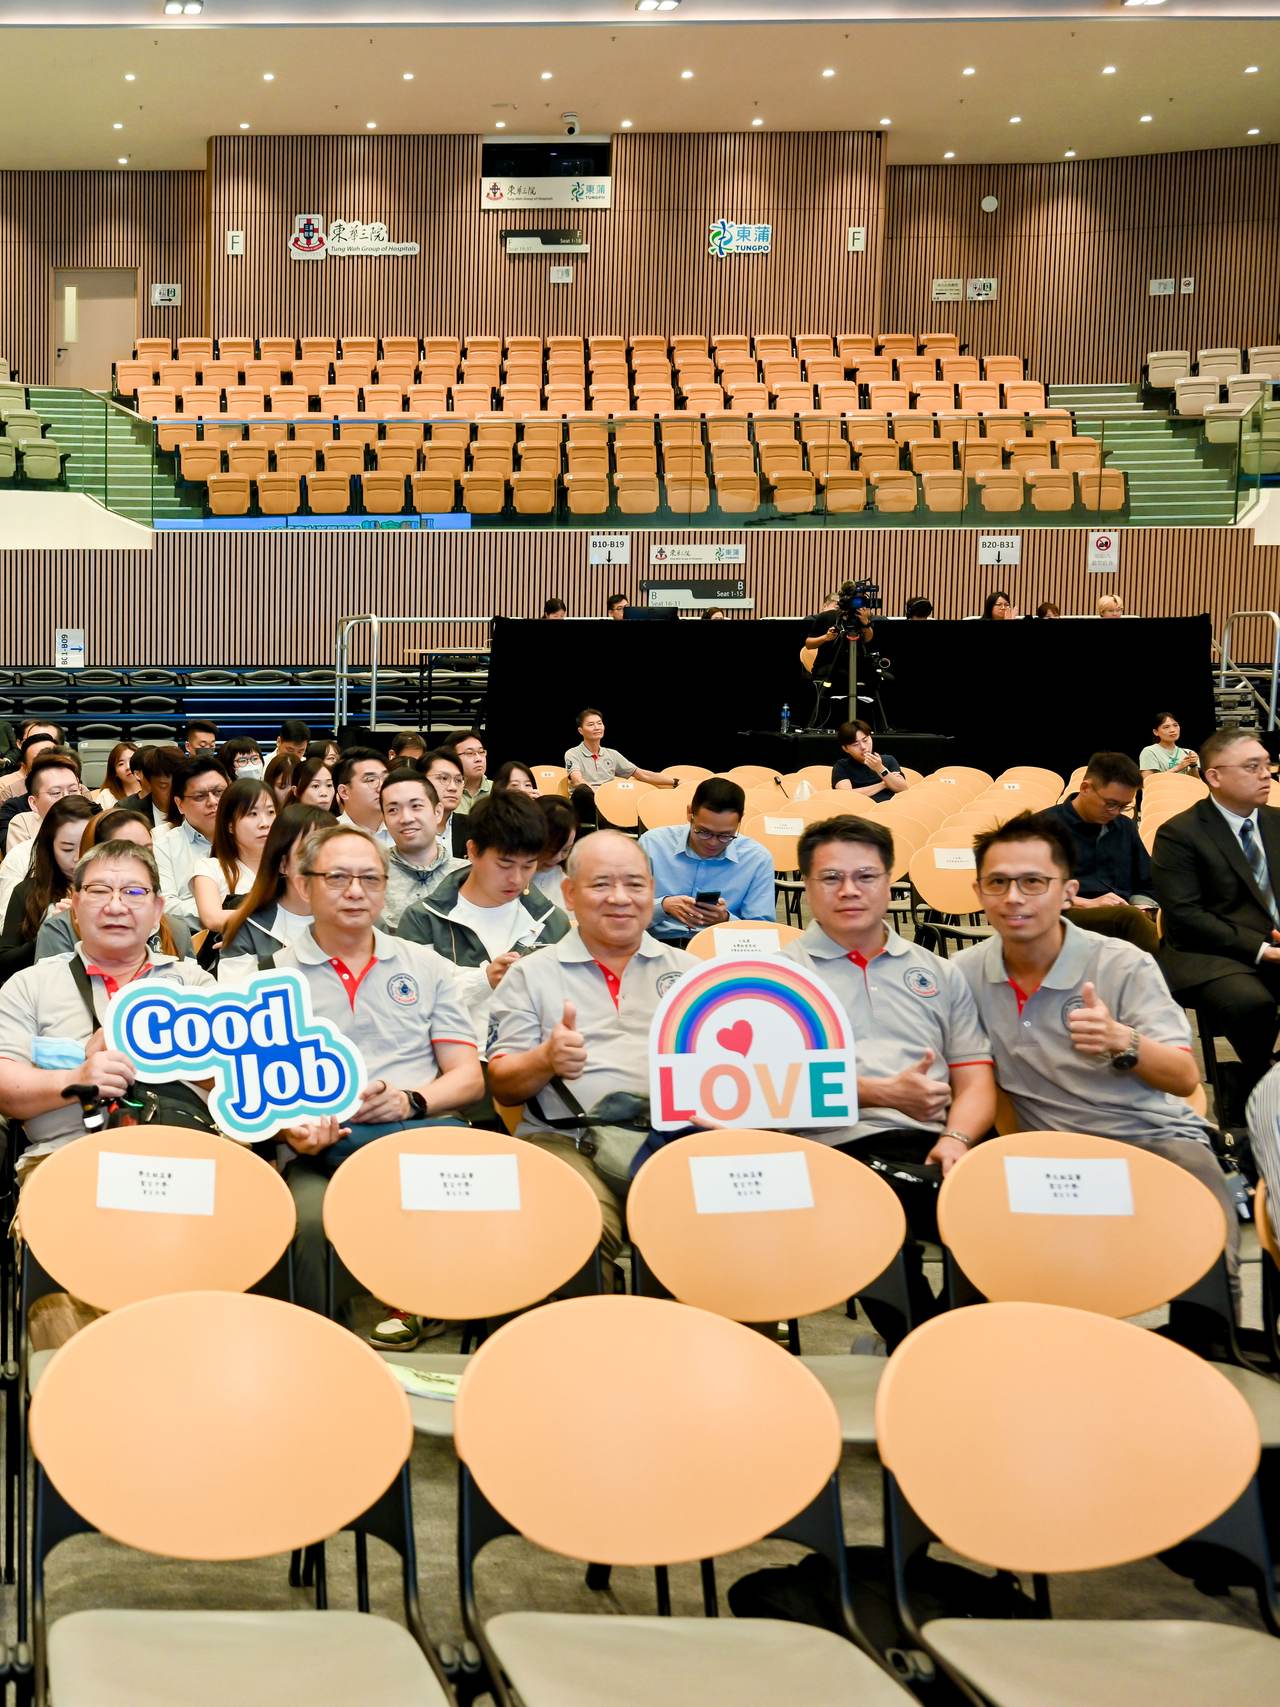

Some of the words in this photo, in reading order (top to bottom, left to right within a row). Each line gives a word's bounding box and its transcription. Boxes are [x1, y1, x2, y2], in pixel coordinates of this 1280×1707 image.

[331, 223, 385, 243] 東華三院
[735, 225, 770, 243] 東蒲
[852, 231, 862, 247] F
[231, 235, 241, 251] F
[592, 540, 625, 548] B10-B19
[981, 541, 1015, 549] B20-B31
[737, 581, 744, 590] B
[651, 591, 657, 600] B
[132, 995, 289, 1054] Good
[240, 1045, 340, 1114] Job
[658, 1061, 849, 1122] LOVE
